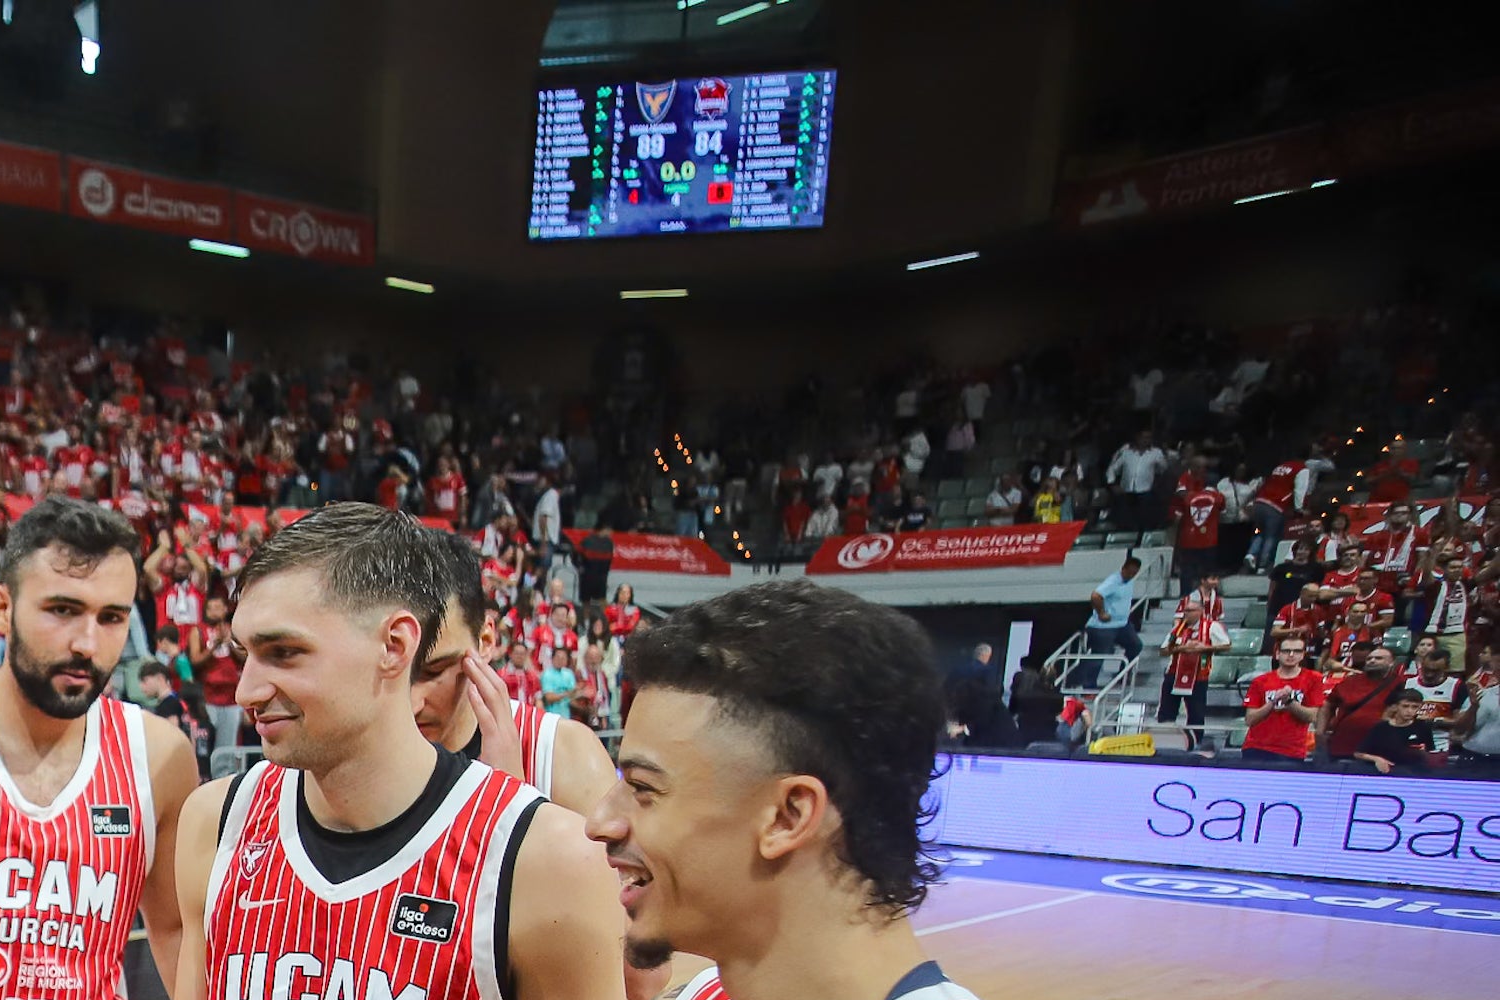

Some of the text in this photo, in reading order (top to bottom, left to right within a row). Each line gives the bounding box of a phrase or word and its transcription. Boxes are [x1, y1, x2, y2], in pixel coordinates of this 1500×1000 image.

[660, 161, 696, 182] 0.0
[249, 206, 361, 256] CROWN
[1146, 779, 1304, 848] San
[399, 904, 426, 923] liga
[396, 918, 448, 939] endesa
[38, 977, 83, 990] MURCIA
